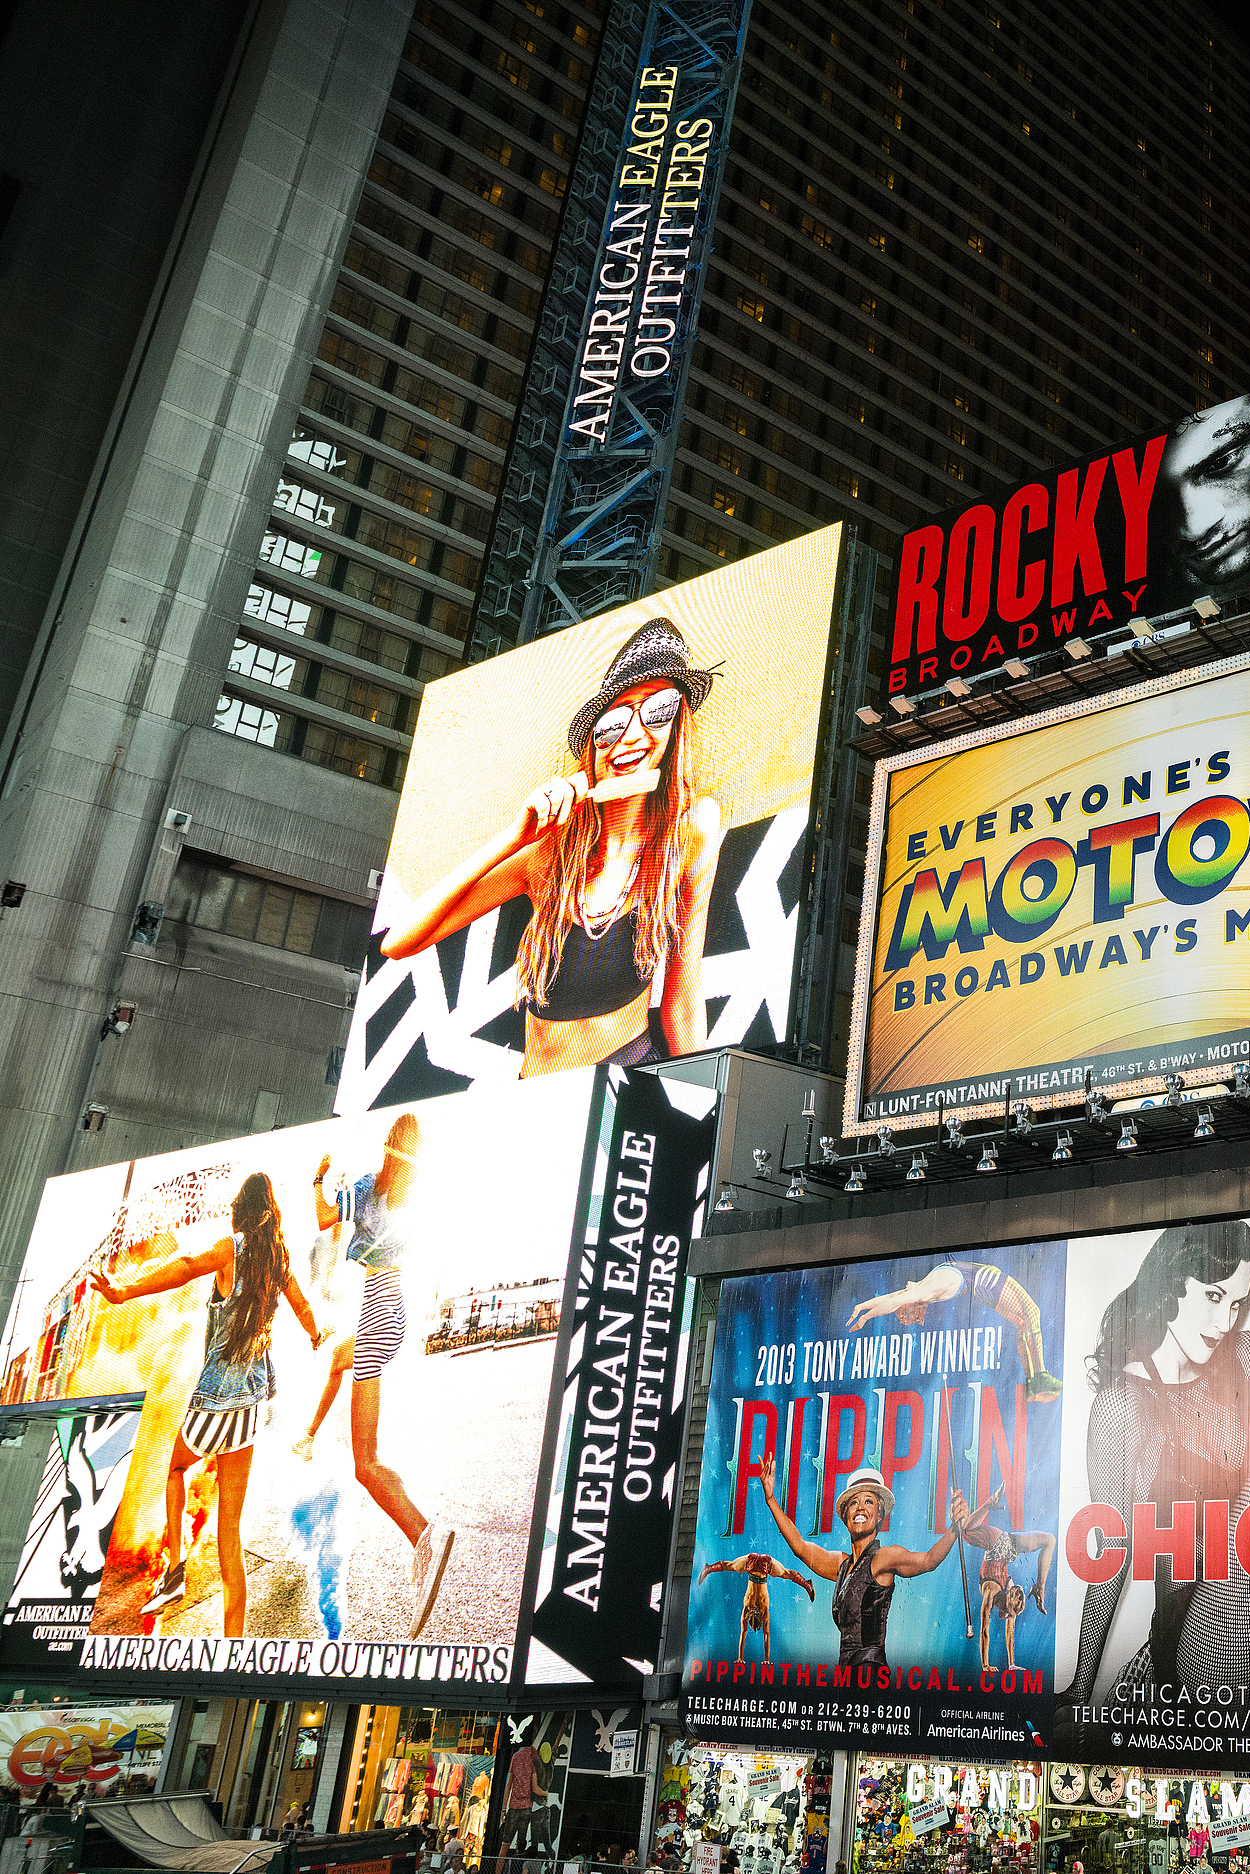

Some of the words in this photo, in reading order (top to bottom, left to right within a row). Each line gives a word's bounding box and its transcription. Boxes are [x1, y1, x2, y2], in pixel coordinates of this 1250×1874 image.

[568, 200, 651, 443] AMERICAN
[619, 66, 678, 188] EAGLE
[631, 118, 713, 378] OUTFITTERS
[891, 434, 1168, 665] ROCKY
[887, 584, 1148, 694] BROADWAY
[906, 750, 1232, 863] EVERYONE'S
[892, 916, 1200, 1013] BROADWAY'S
[1127, 1060, 1145, 1074] ST.
[1148, 1059, 1157, 1071] &
[1160, 1052, 1197, 1069] B'WAY
[562, 1301, 634, 1613] AMERICAN
[603, 1130, 656, 1297] EAGLE
[622, 1232, 680, 1503] OUTFITTERS
[755, 1343, 795, 1388] 2013
[802, 1337, 850, 1384] TONY
[852, 1332, 913, 1379] AWARD
[919, 1325, 1002, 1374] WINNER!
[720, 1382, 1030, 1540] PIPPIN
[15, 1605, 82, 1622] AMERICAN
[32, 1625, 89, 1640] OUTFITTER
[83, 1637, 221, 1672] AMERICAN
[227, 1642, 310, 1676] EAGLE
[319, 1642, 509, 1684] OUTFITTERS
[690, 1659, 1044, 1694] PIPPINTHEMUSICAL.COM
[687, 1696, 798, 1715] TELECHARGE.COM
[801, 1705, 814, 1715] OR
[818, 1702, 912, 1720] 212-239-6200
[693, 1715, 720, 1726] MUSIC
[721, 1716, 738, 1727] BOX
[740, 1716, 780, 1730] THEATRE,
[800, 1720, 814, 1731] ST.
[817, 1721, 846, 1733] BTWN.
[862, 1723, 870, 1733] &
[886, 1724, 912, 1736] AVES.
[941, 1708, 973, 1719] OFFICIAL
[975, 1710, 1005, 1721] AIRLINE
[927, 1724, 980, 1739] American
[981, 1726, 1025, 1742] Airlines
[1127, 1734, 1225, 1753] AMBASSADOR
[907, 1763, 1036, 1811] GRAND
